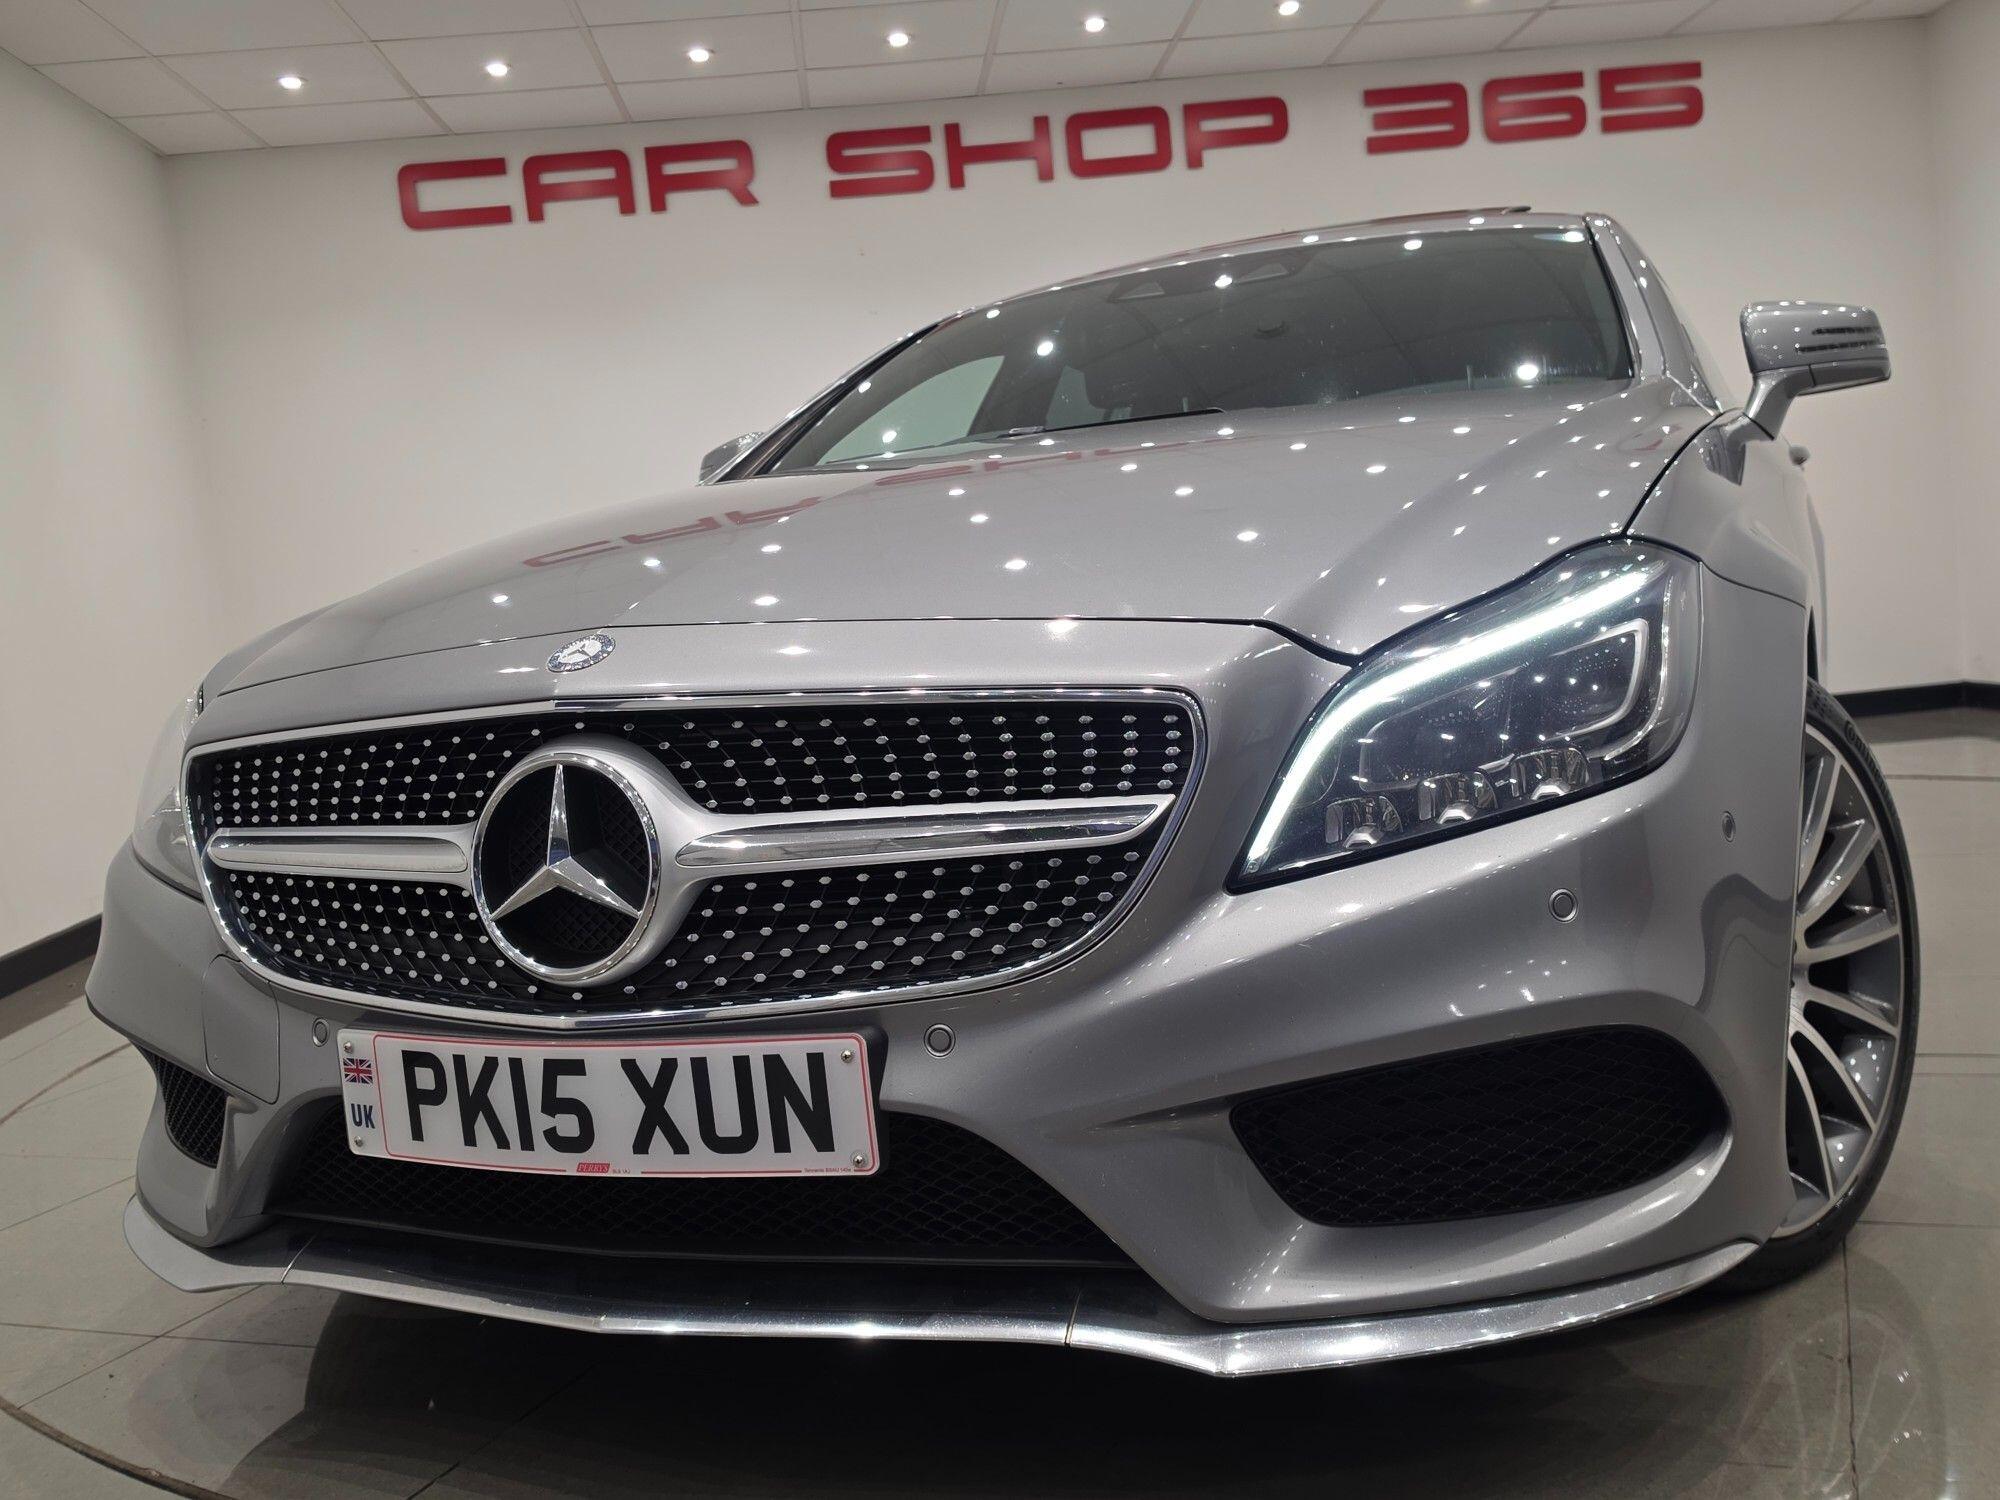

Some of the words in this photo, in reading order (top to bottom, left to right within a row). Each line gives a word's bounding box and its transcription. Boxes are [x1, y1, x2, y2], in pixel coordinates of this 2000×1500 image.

[398, 140, 756, 230] CAR
[826, 97, 1288, 198] SHOP
[1365, 63, 1703, 154] 365
[350, 1103, 375, 1129] UK
[402, 1050, 595, 1153] PK15
[620, 1053, 835, 1154] XUN
[578, 1163, 609, 1173] PERRYS
